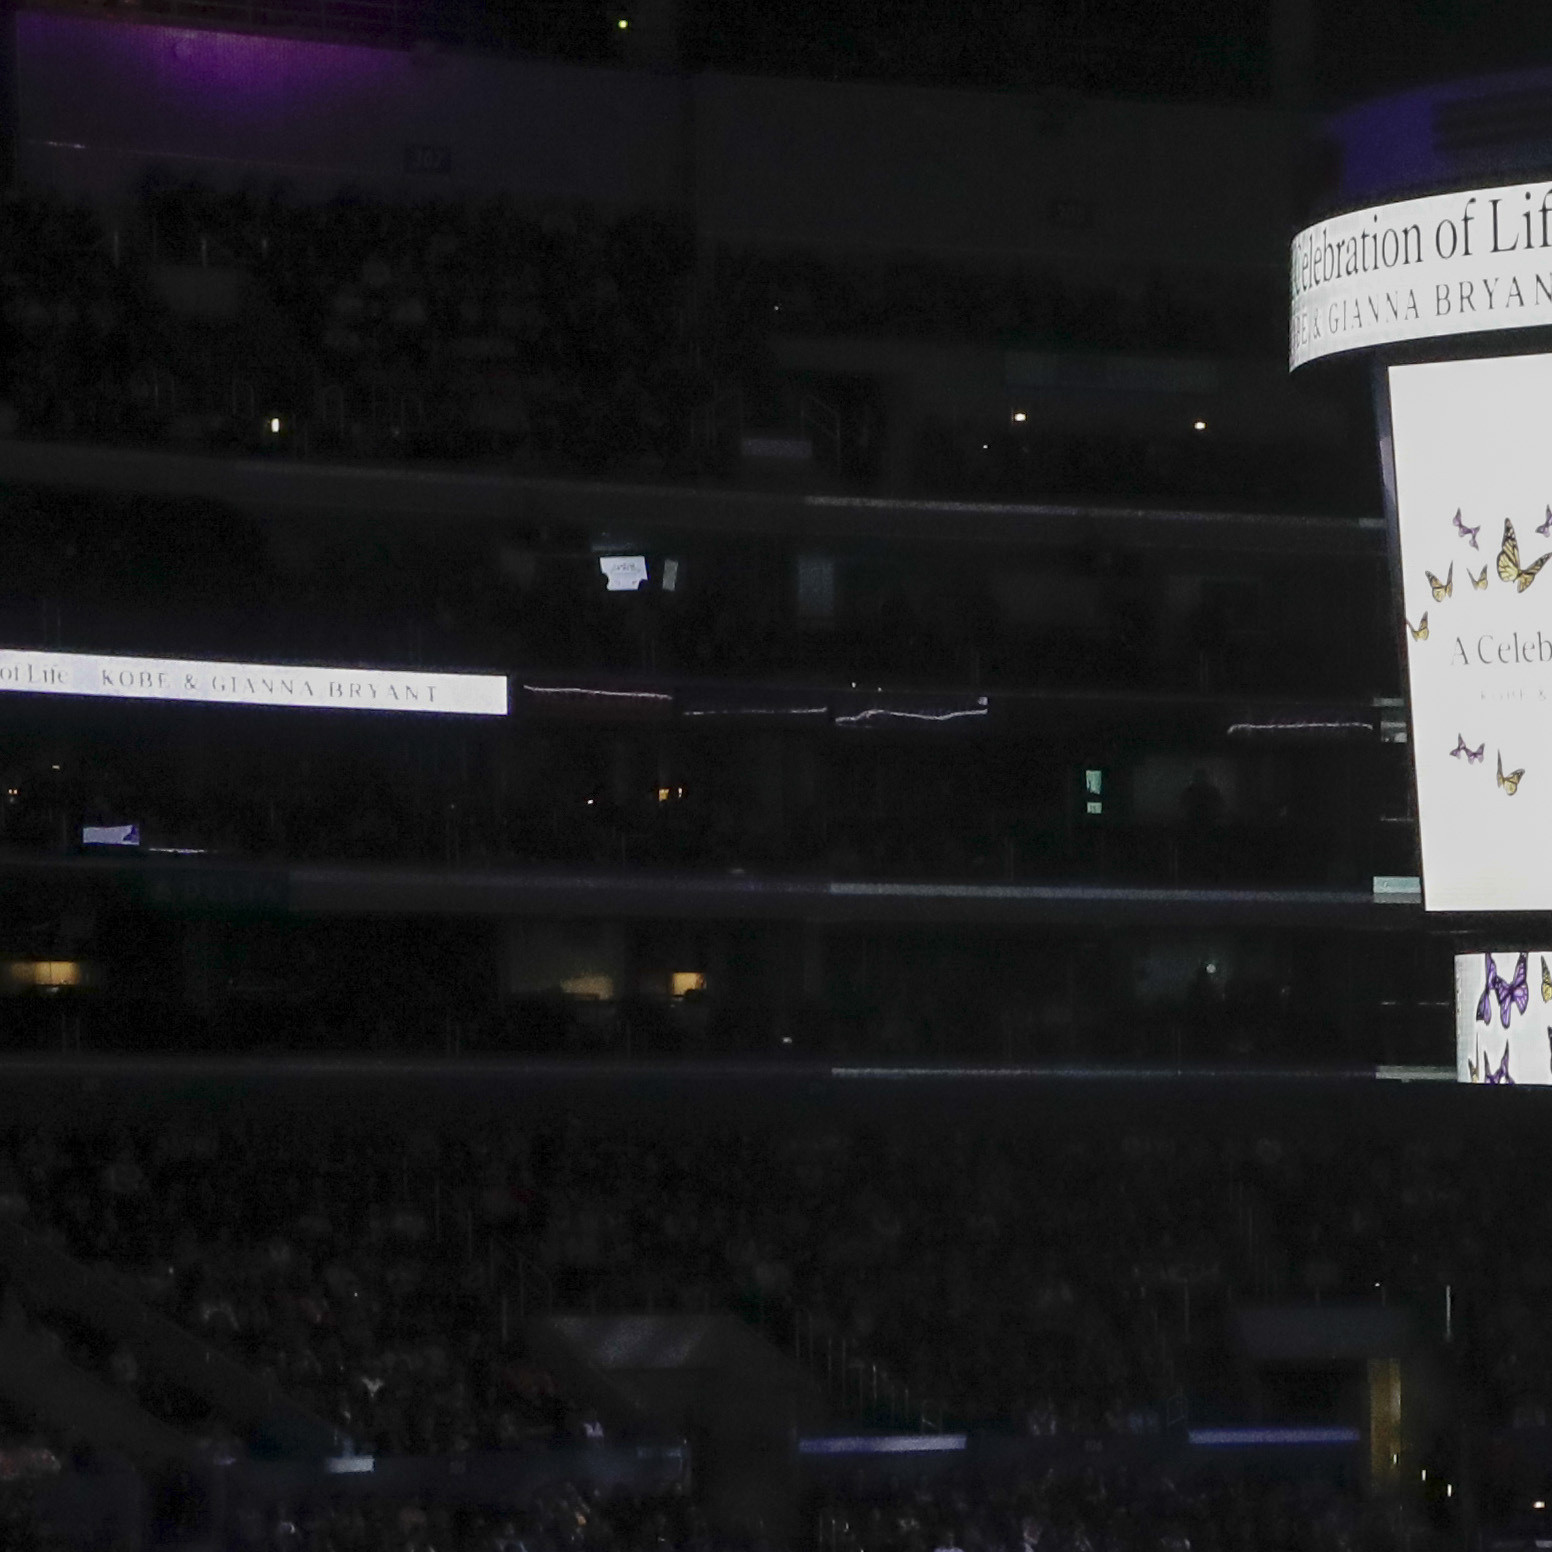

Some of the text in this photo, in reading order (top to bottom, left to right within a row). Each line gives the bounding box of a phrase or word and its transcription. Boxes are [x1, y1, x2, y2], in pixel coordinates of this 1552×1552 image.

[1435, 197, 1477, 259] of
[1328, 289, 1420, 335] GIANNA
[1451, 635, 1470, 667] A
[27, 662, 68, 685] Life
[102, 669, 170, 688] KOBE
[184, 673, 198, 689] &
[212, 675, 315, 697] GIANNA
[329, 681, 438, 703] BRYANT
